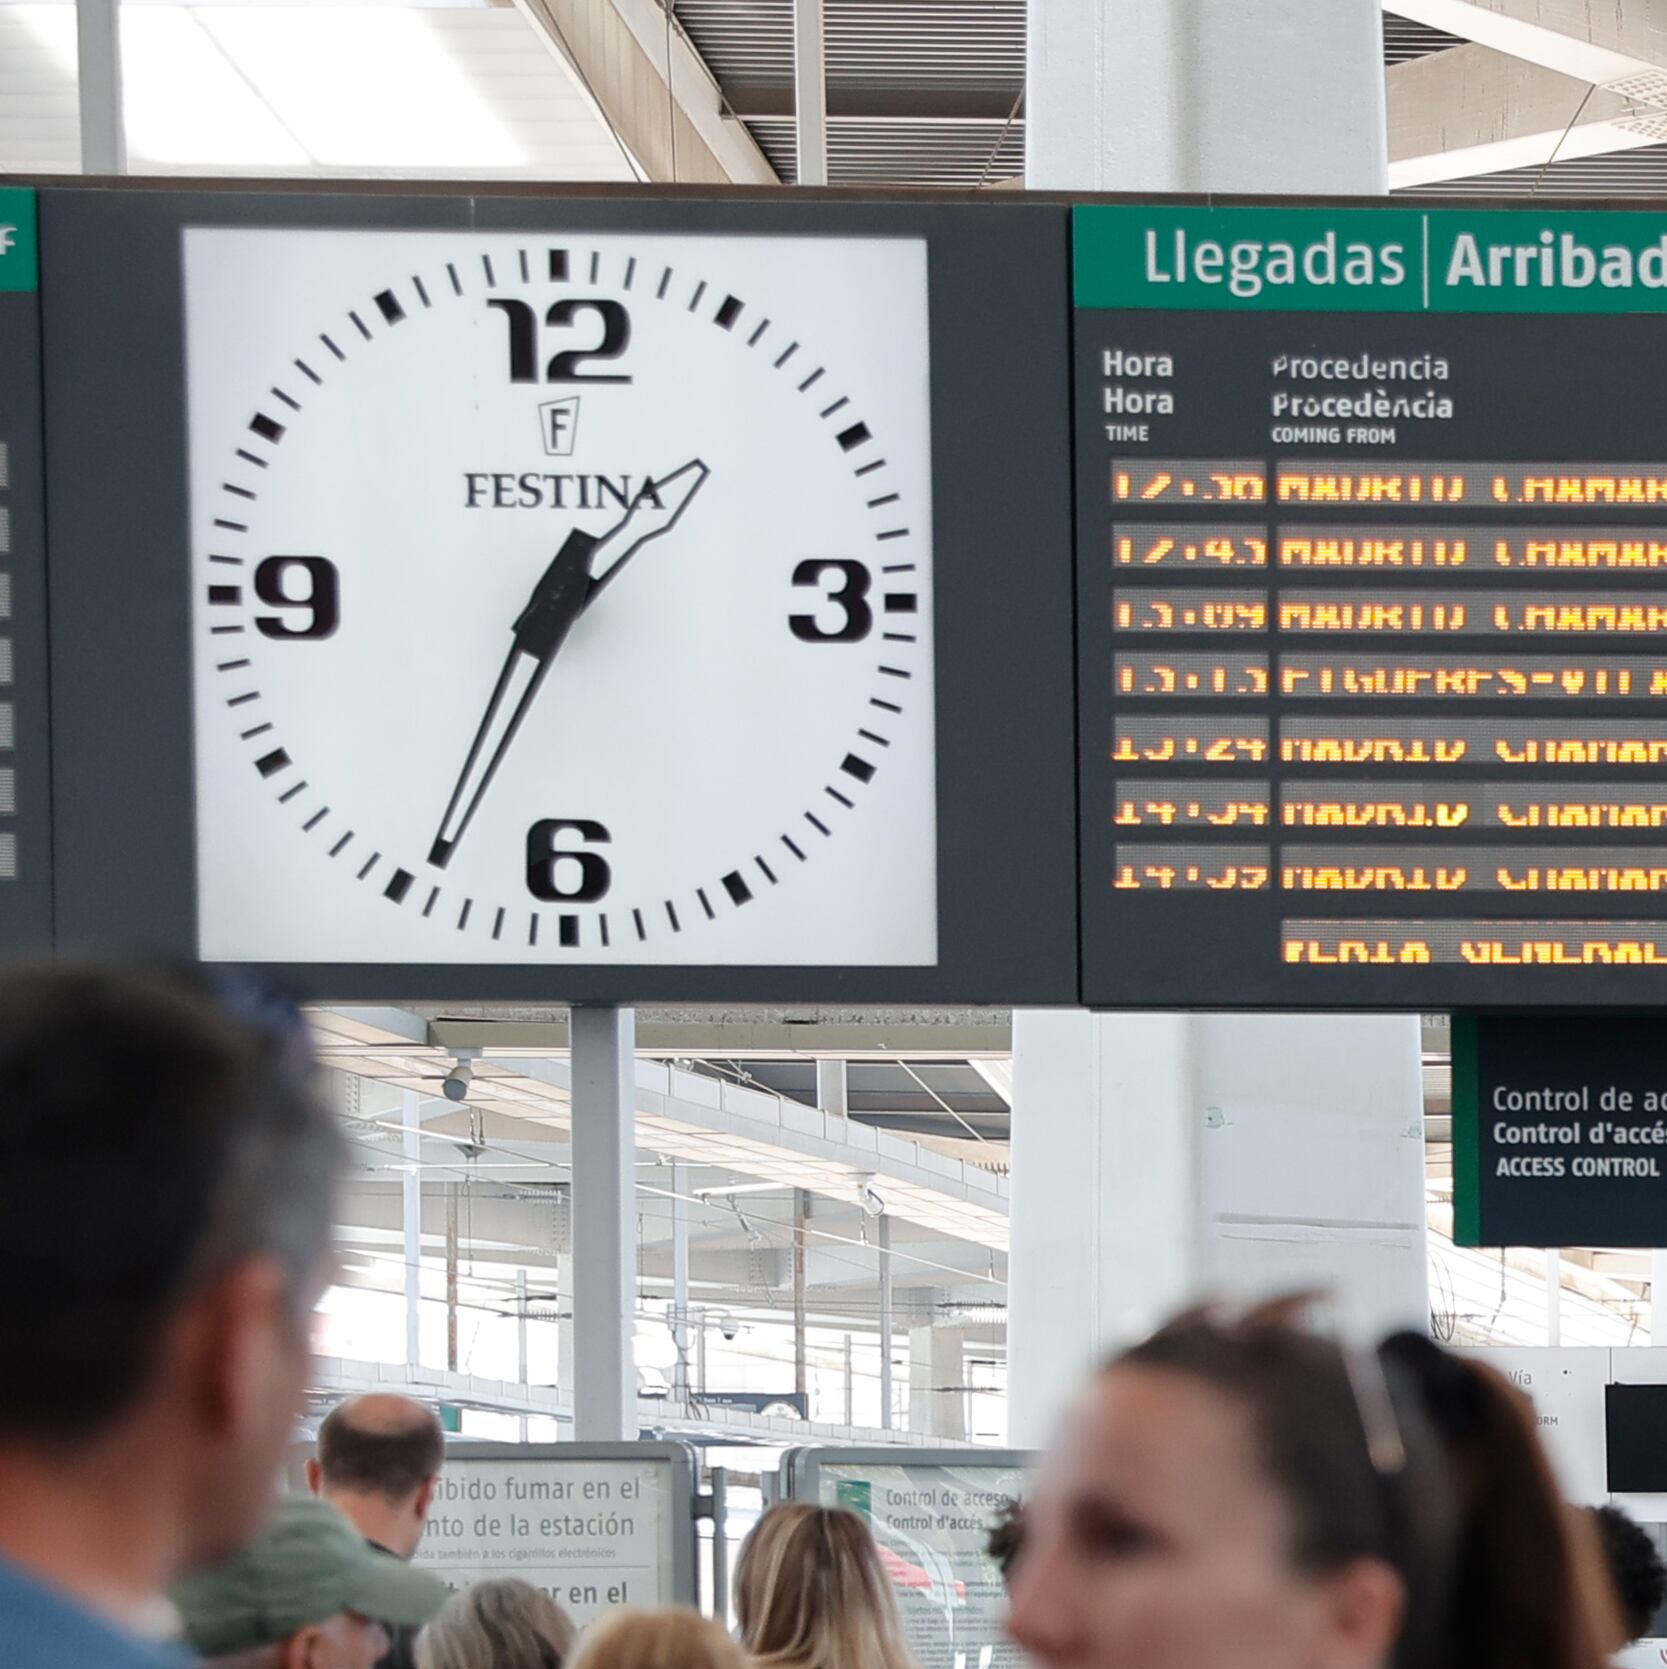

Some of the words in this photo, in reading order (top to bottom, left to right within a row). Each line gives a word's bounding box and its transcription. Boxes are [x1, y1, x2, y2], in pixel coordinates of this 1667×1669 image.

[1146, 229, 1405, 298] Llegadas
[487, 298, 632, 384] 12
[1103, 350, 1173, 377] Hora
[1104, 387, 1174, 414] Hora
[1105, 424, 1149, 442] TIME
[1271, 426, 1341, 444] COMING
[1346, 427, 1396, 444] FROM
[464, 473, 666, 511] FESTINA
[253, 555, 339, 640] 9
[788, 558, 873, 643] 3
[525, 818, 611, 903] 6
[1493, 1086, 1588, 1111] Control
[1599, 1086, 1633, 1112] de
[1493, 1122, 1580, 1144] Control
[1496, 1157, 1566, 1177] ACCESS
[1571, 1157, 1661, 1177] CONTROL
[438, 1478, 496, 1500] ibido
[505, 1477, 574, 1500] fumar
[583, 1481, 610, 1499] en
[620, 1477, 640, 1499] el
[473, 1514, 501, 1537] de
[511, 1514, 529, 1537] la
[539, 1512, 634, 1537] estación
[569, 1585, 597, 1604] en
[607, 1582, 628, 1604] el
